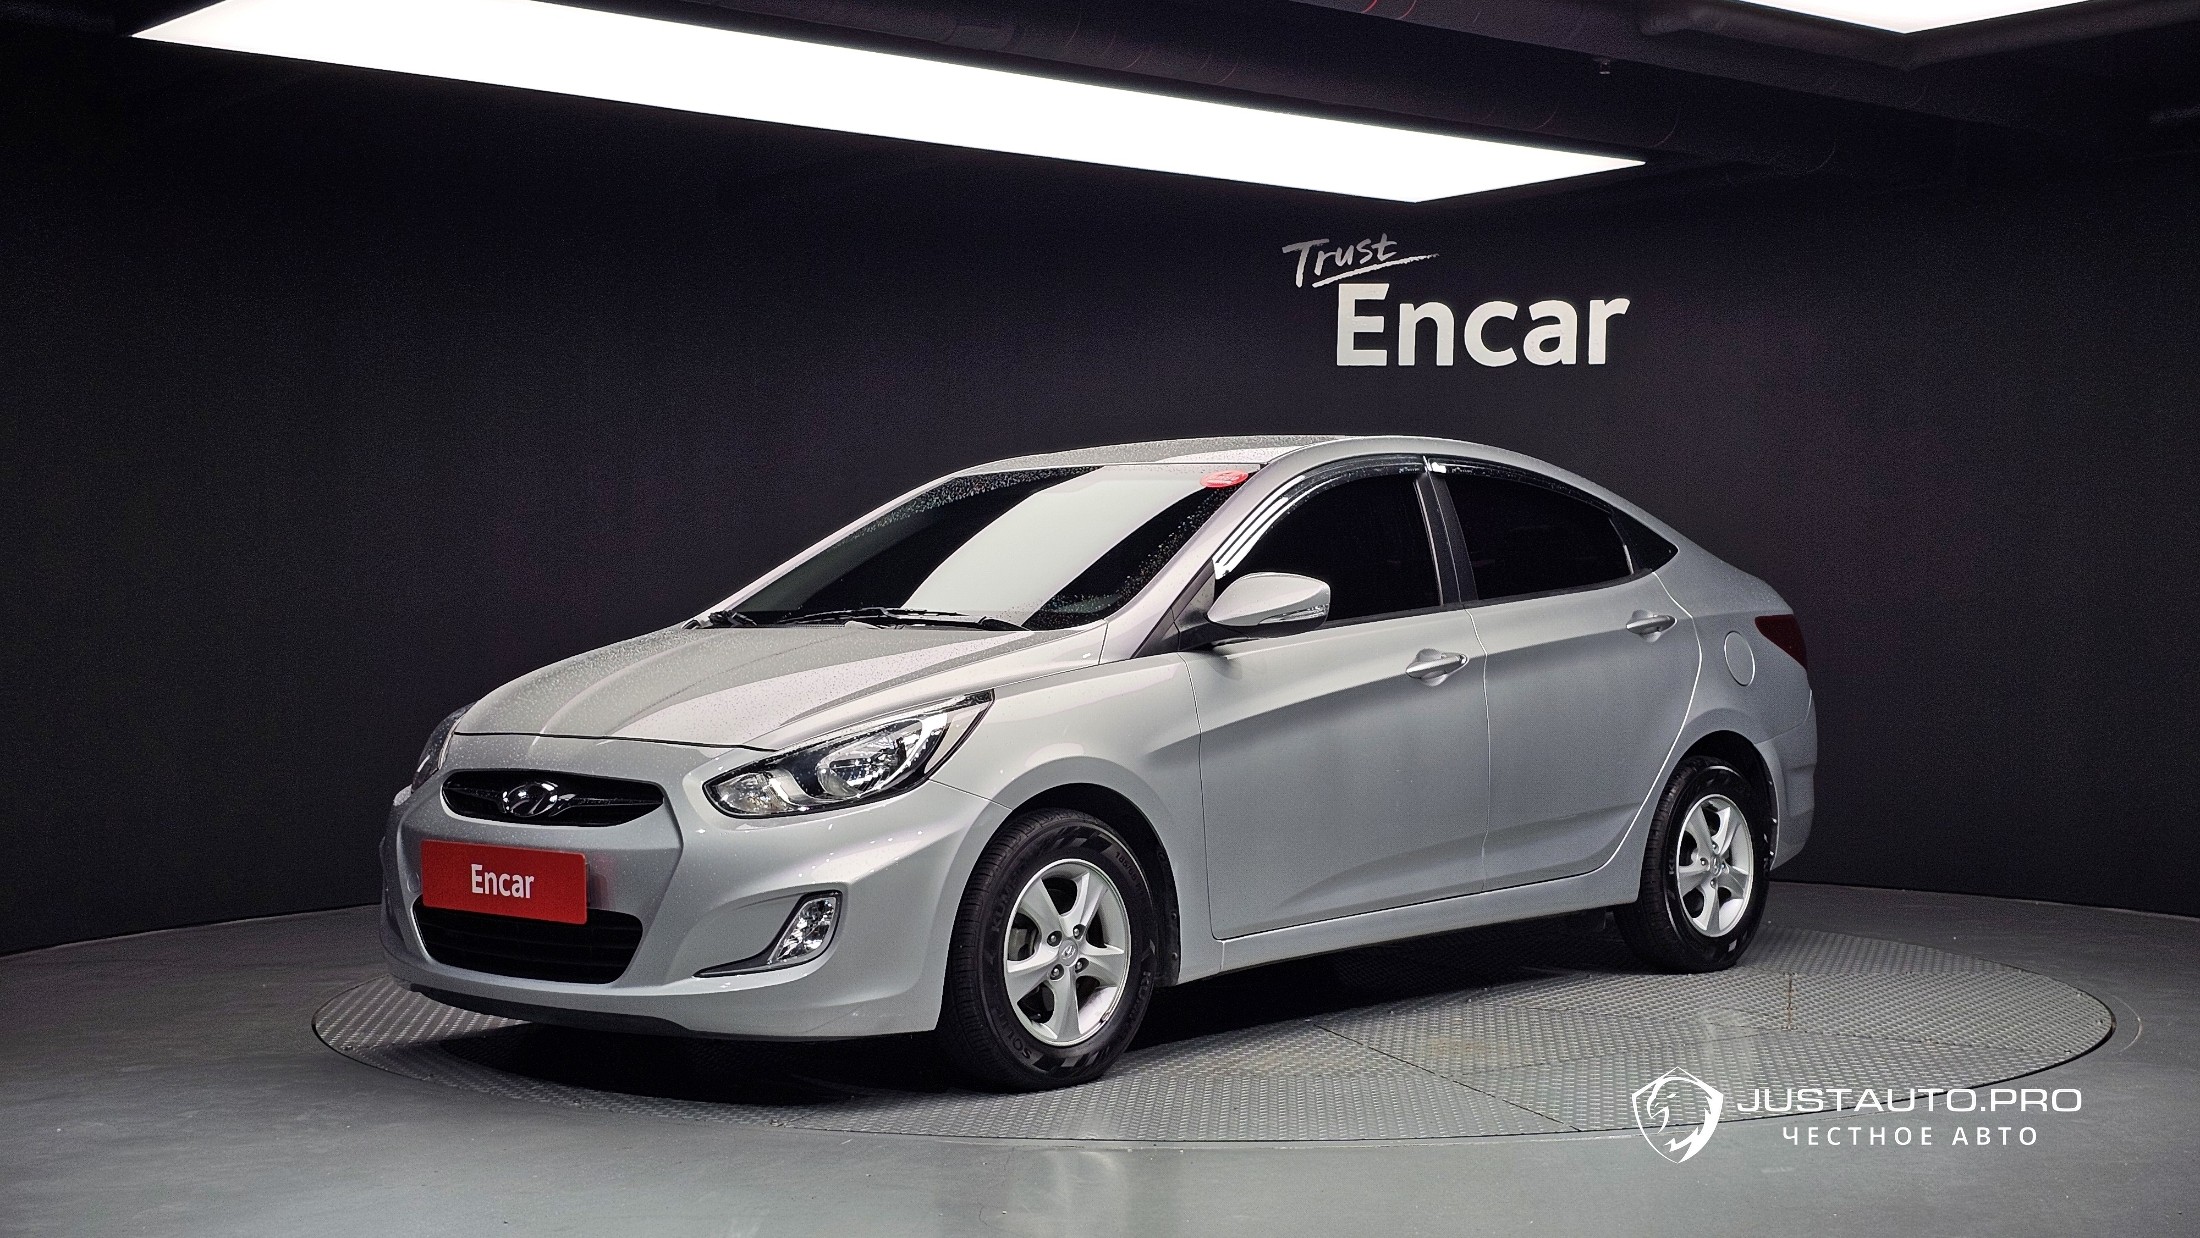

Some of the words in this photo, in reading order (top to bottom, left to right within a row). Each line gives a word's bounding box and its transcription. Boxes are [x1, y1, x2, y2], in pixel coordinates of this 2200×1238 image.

[1282, 233, 1400, 288] Trust
[1336, 282, 1631, 368] Encar
[470, 863, 535, 899] Encar
